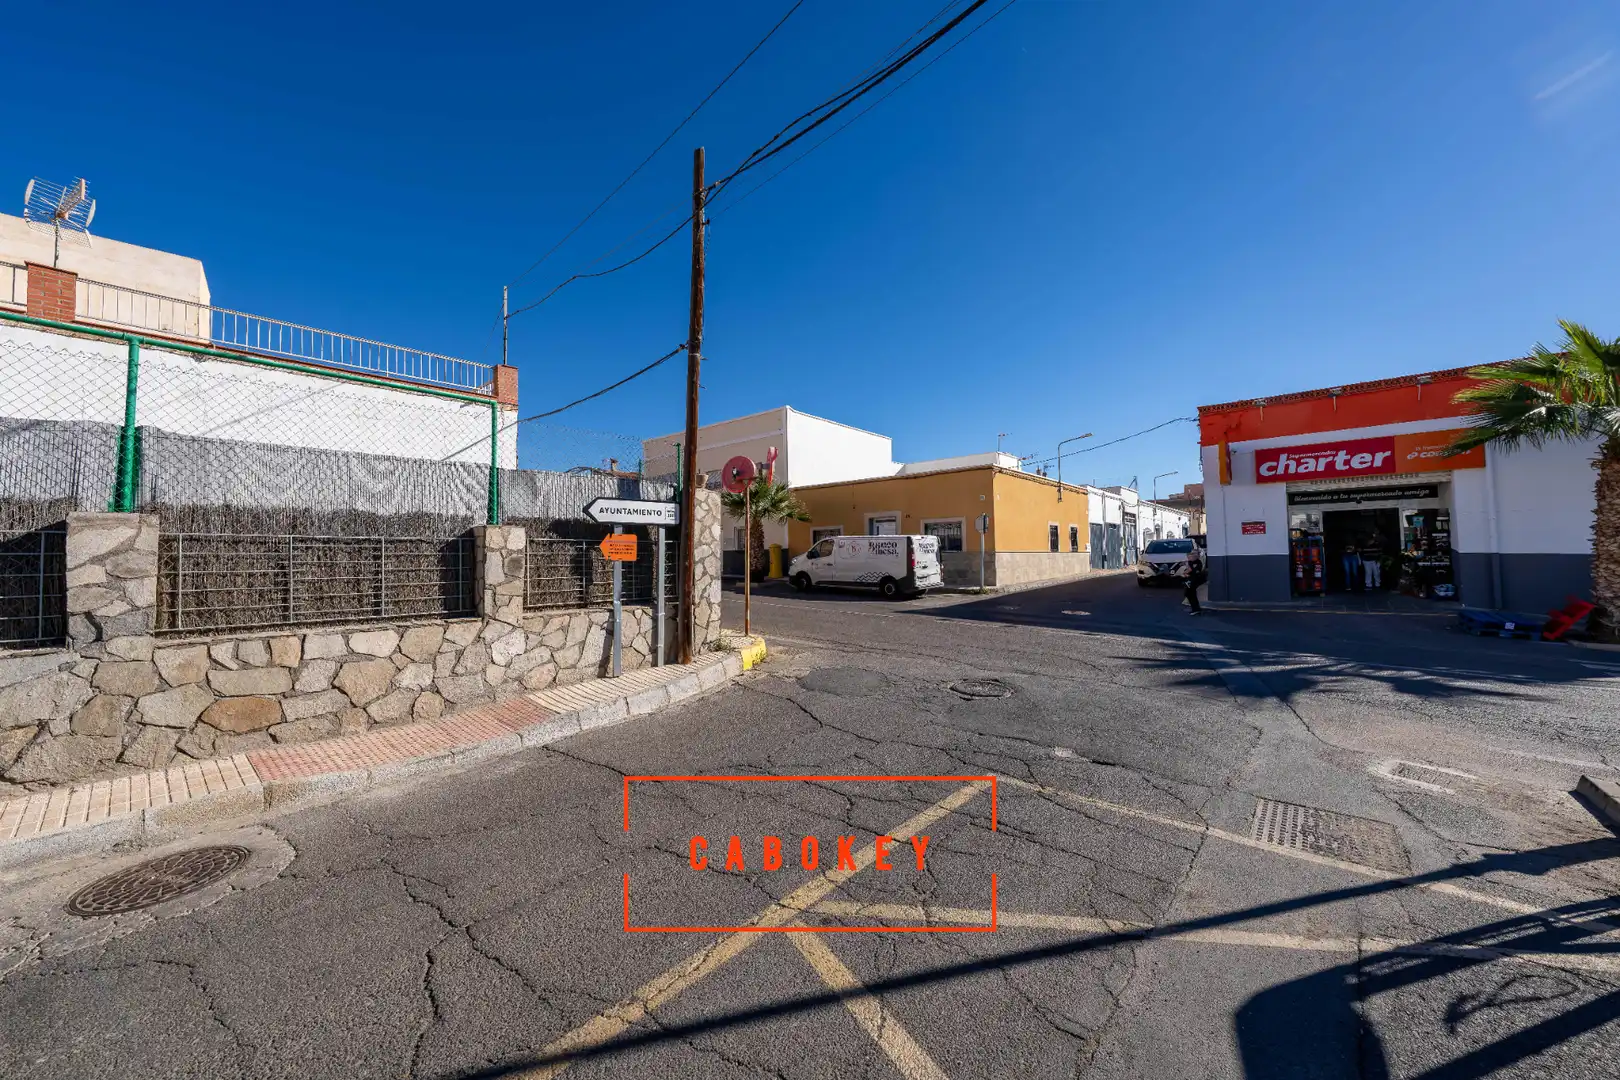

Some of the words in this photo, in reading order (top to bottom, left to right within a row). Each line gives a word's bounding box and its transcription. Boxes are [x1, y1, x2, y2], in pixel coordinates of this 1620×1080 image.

[1259, 449, 1391, 476] charter
[1294, 493, 1332, 502] Bienvenido
[1350, 489, 1403, 500] supermercado
[1404, 488, 1430, 497] amigo
[599, 507, 662, 517] AYUNTAMIENTO
